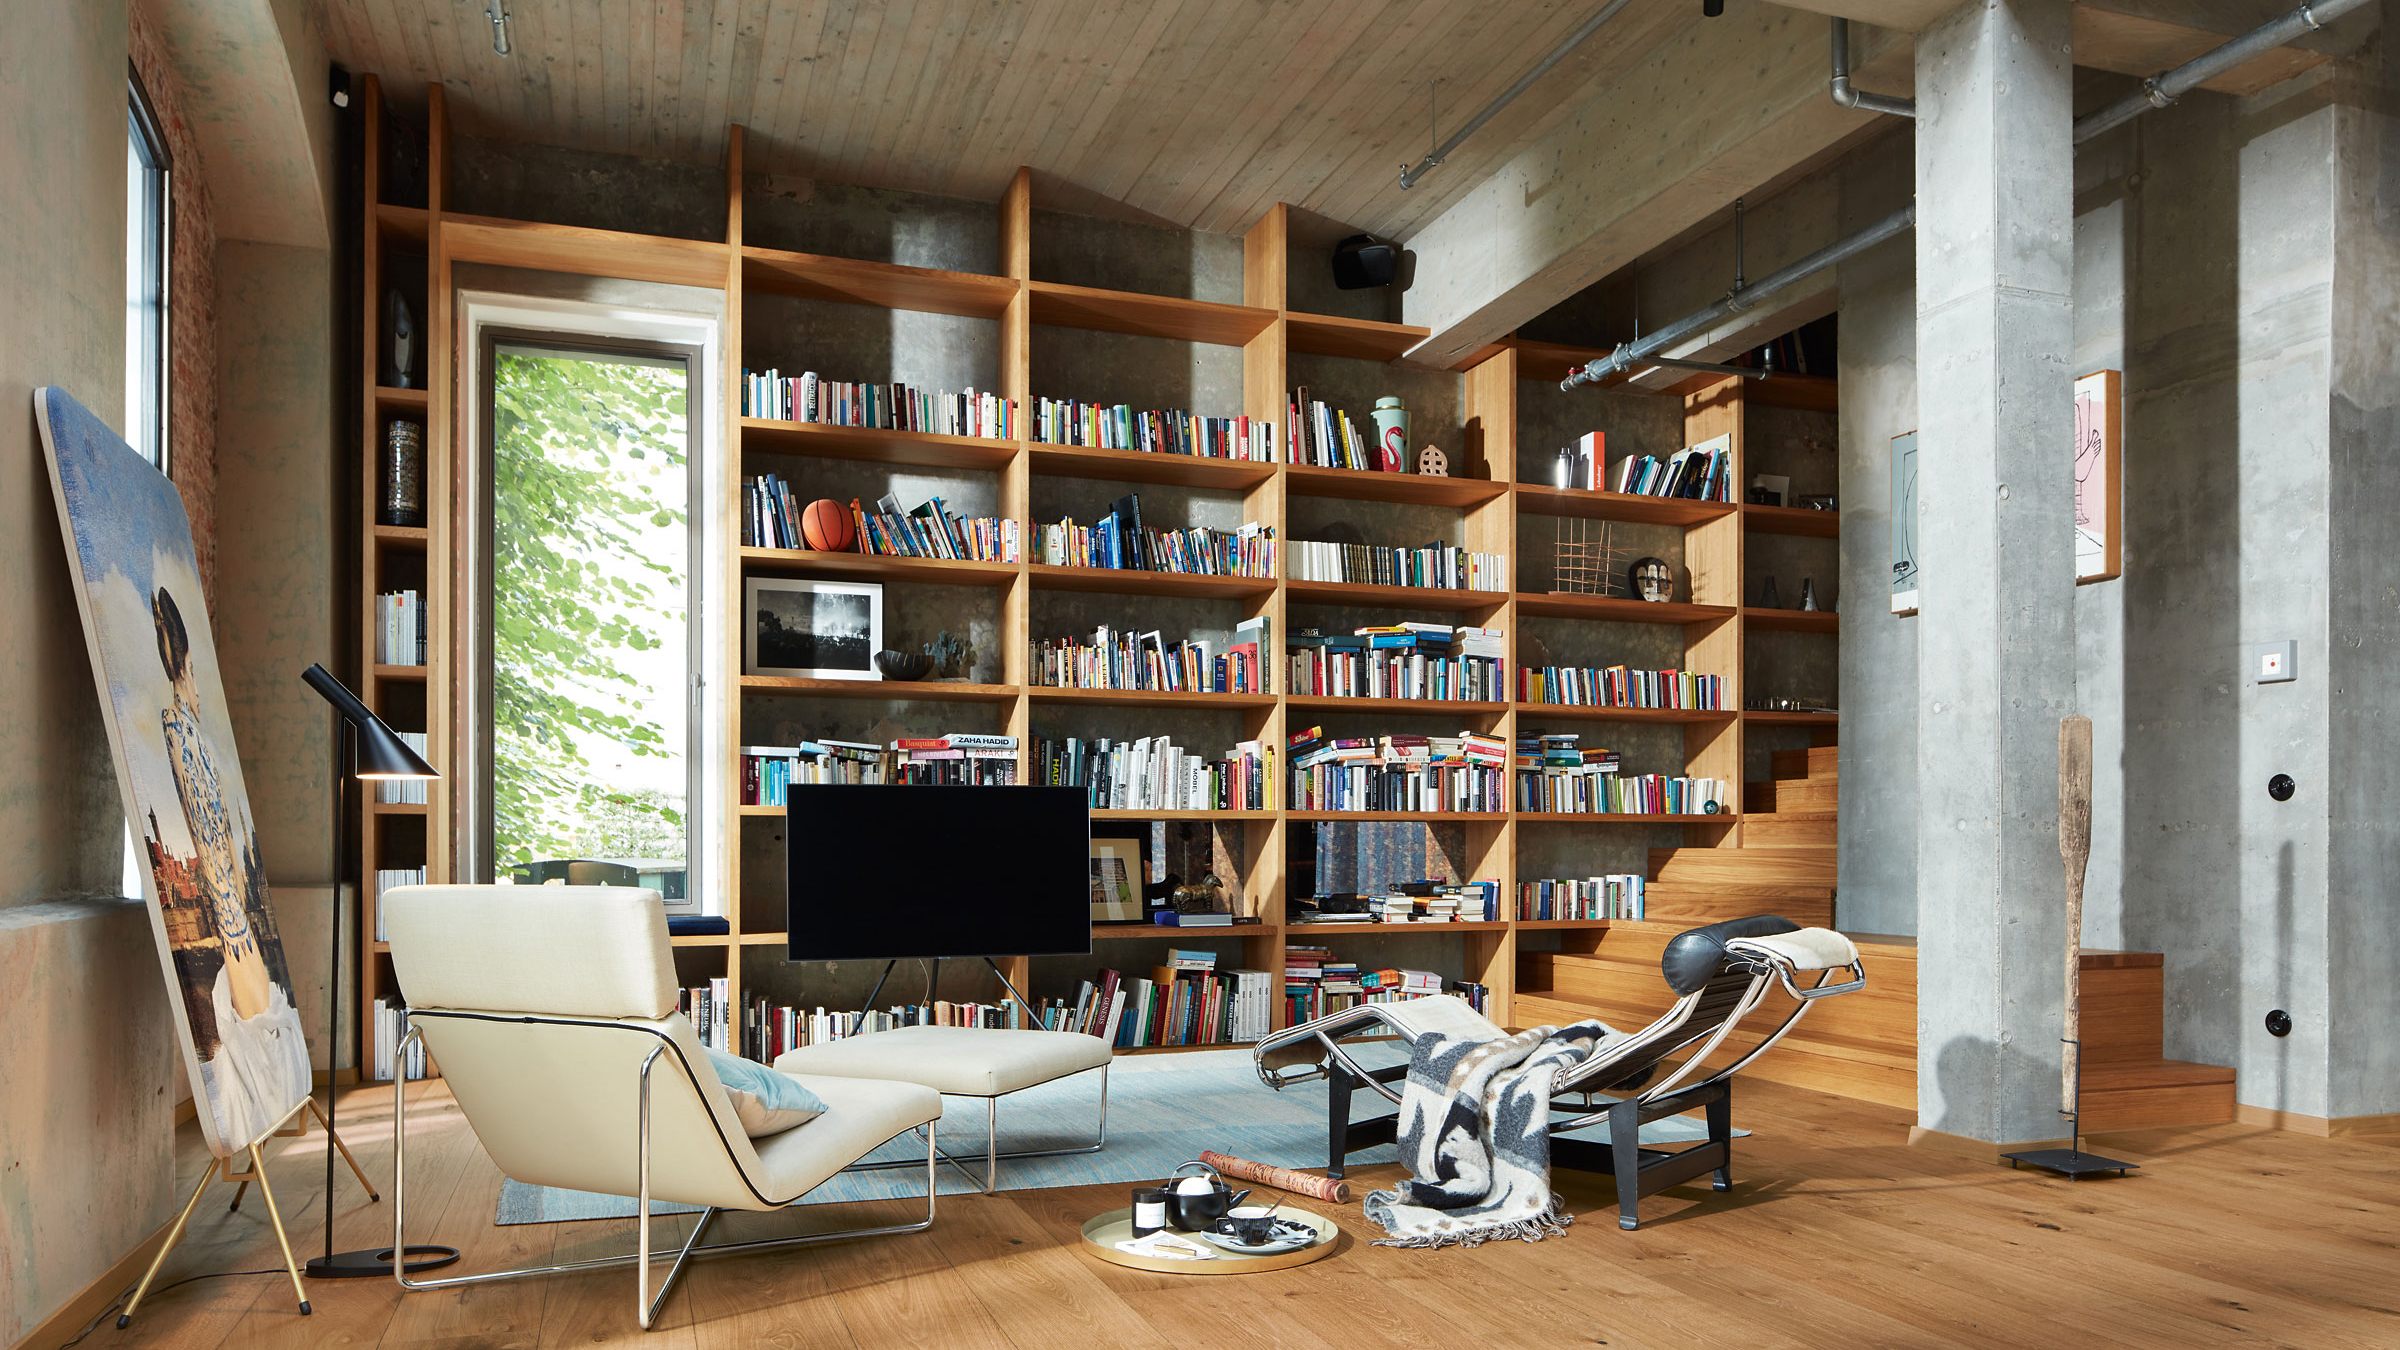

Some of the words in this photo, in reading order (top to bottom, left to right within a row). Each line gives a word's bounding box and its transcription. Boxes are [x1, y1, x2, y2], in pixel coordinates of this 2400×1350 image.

[1248, 650, 1257, 659] 36
[983, 738, 1010, 746] HADID
[974, 749, 1004, 757] ARAKI
[1052, 758, 1060, 785] HADI
[1099, 996, 1110, 1025] GENESIS
